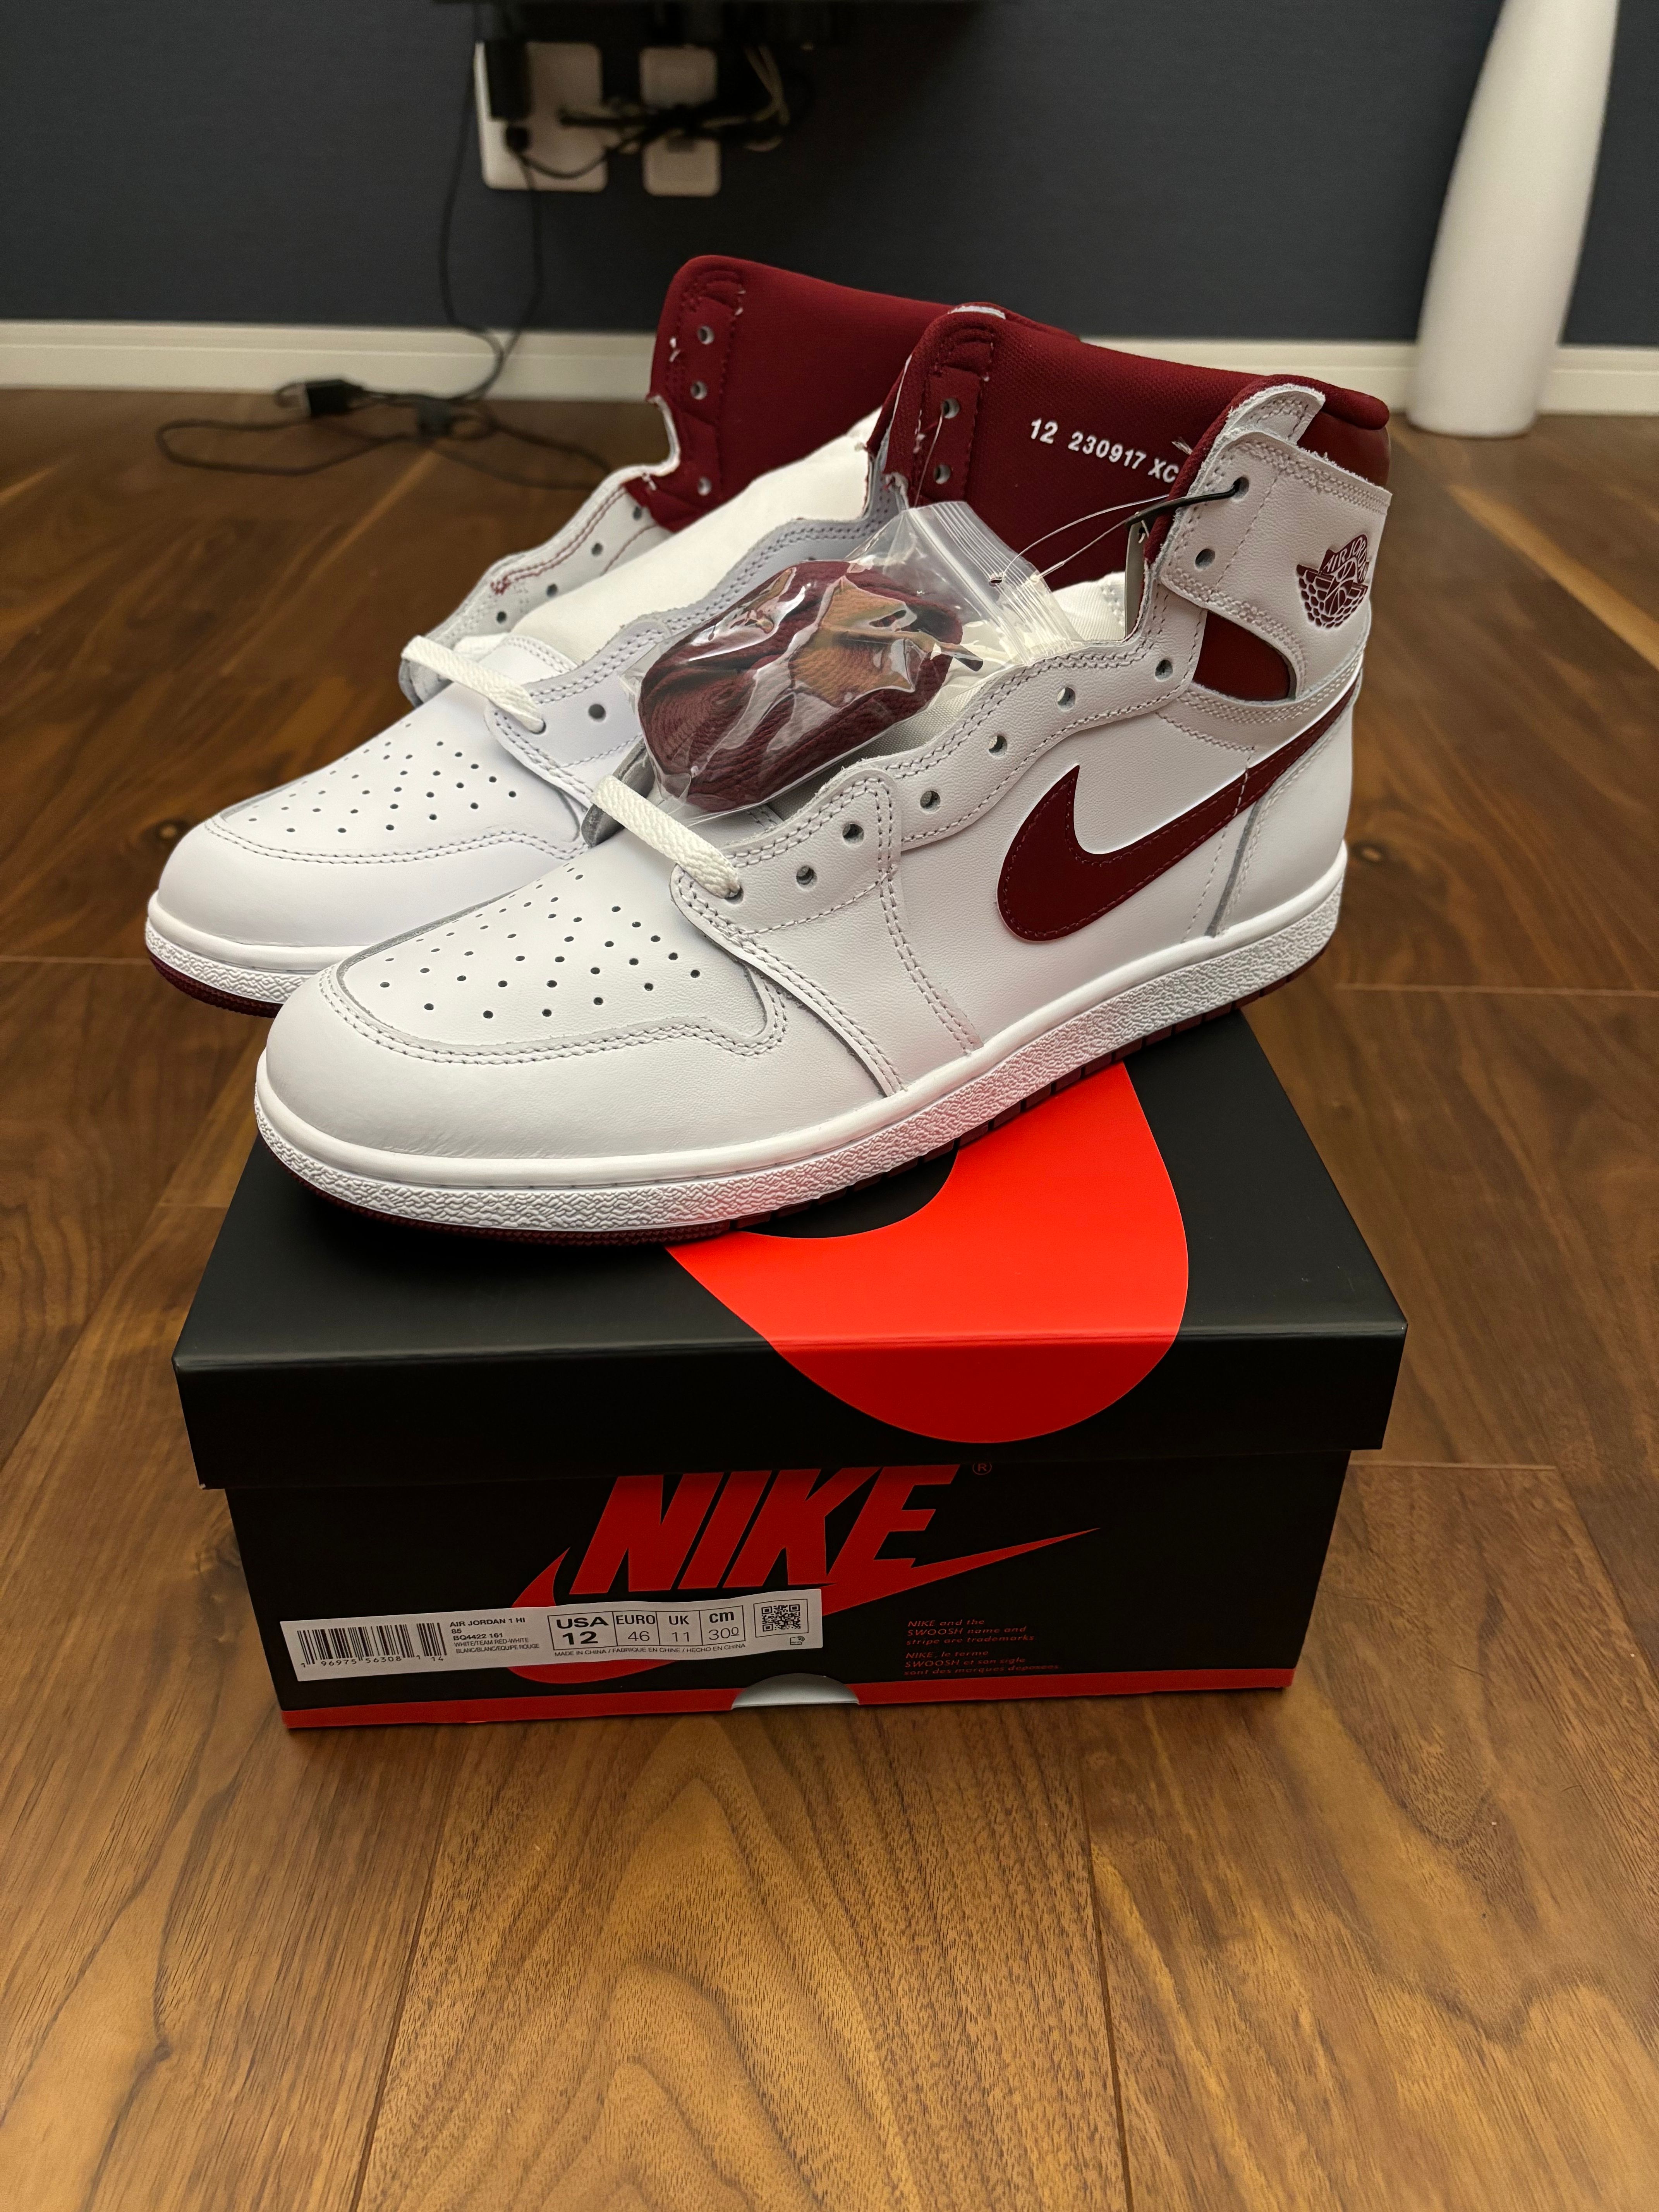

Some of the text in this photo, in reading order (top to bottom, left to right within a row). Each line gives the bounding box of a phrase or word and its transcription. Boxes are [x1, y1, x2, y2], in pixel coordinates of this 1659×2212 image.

[1030, 418, 1058, 444] 12
[1068, 431, 1146, 470] 230917
[1323, 548, 1348, 572] AIR
[569, 1464, 960, 1594] NIKE
[556, 1616, 609, 1629] USA
[616, 1614, 656, 1625] EURO
[668, 1615, 690, 1625] UK
[709, 1611, 734, 1623] cm
[562, 1631, 598, 1645] 12
[628, 1631, 650, 1642] 46
[672, 1632, 690, 1642] 11
[907, 1628, 963, 1636] SWOOSH
